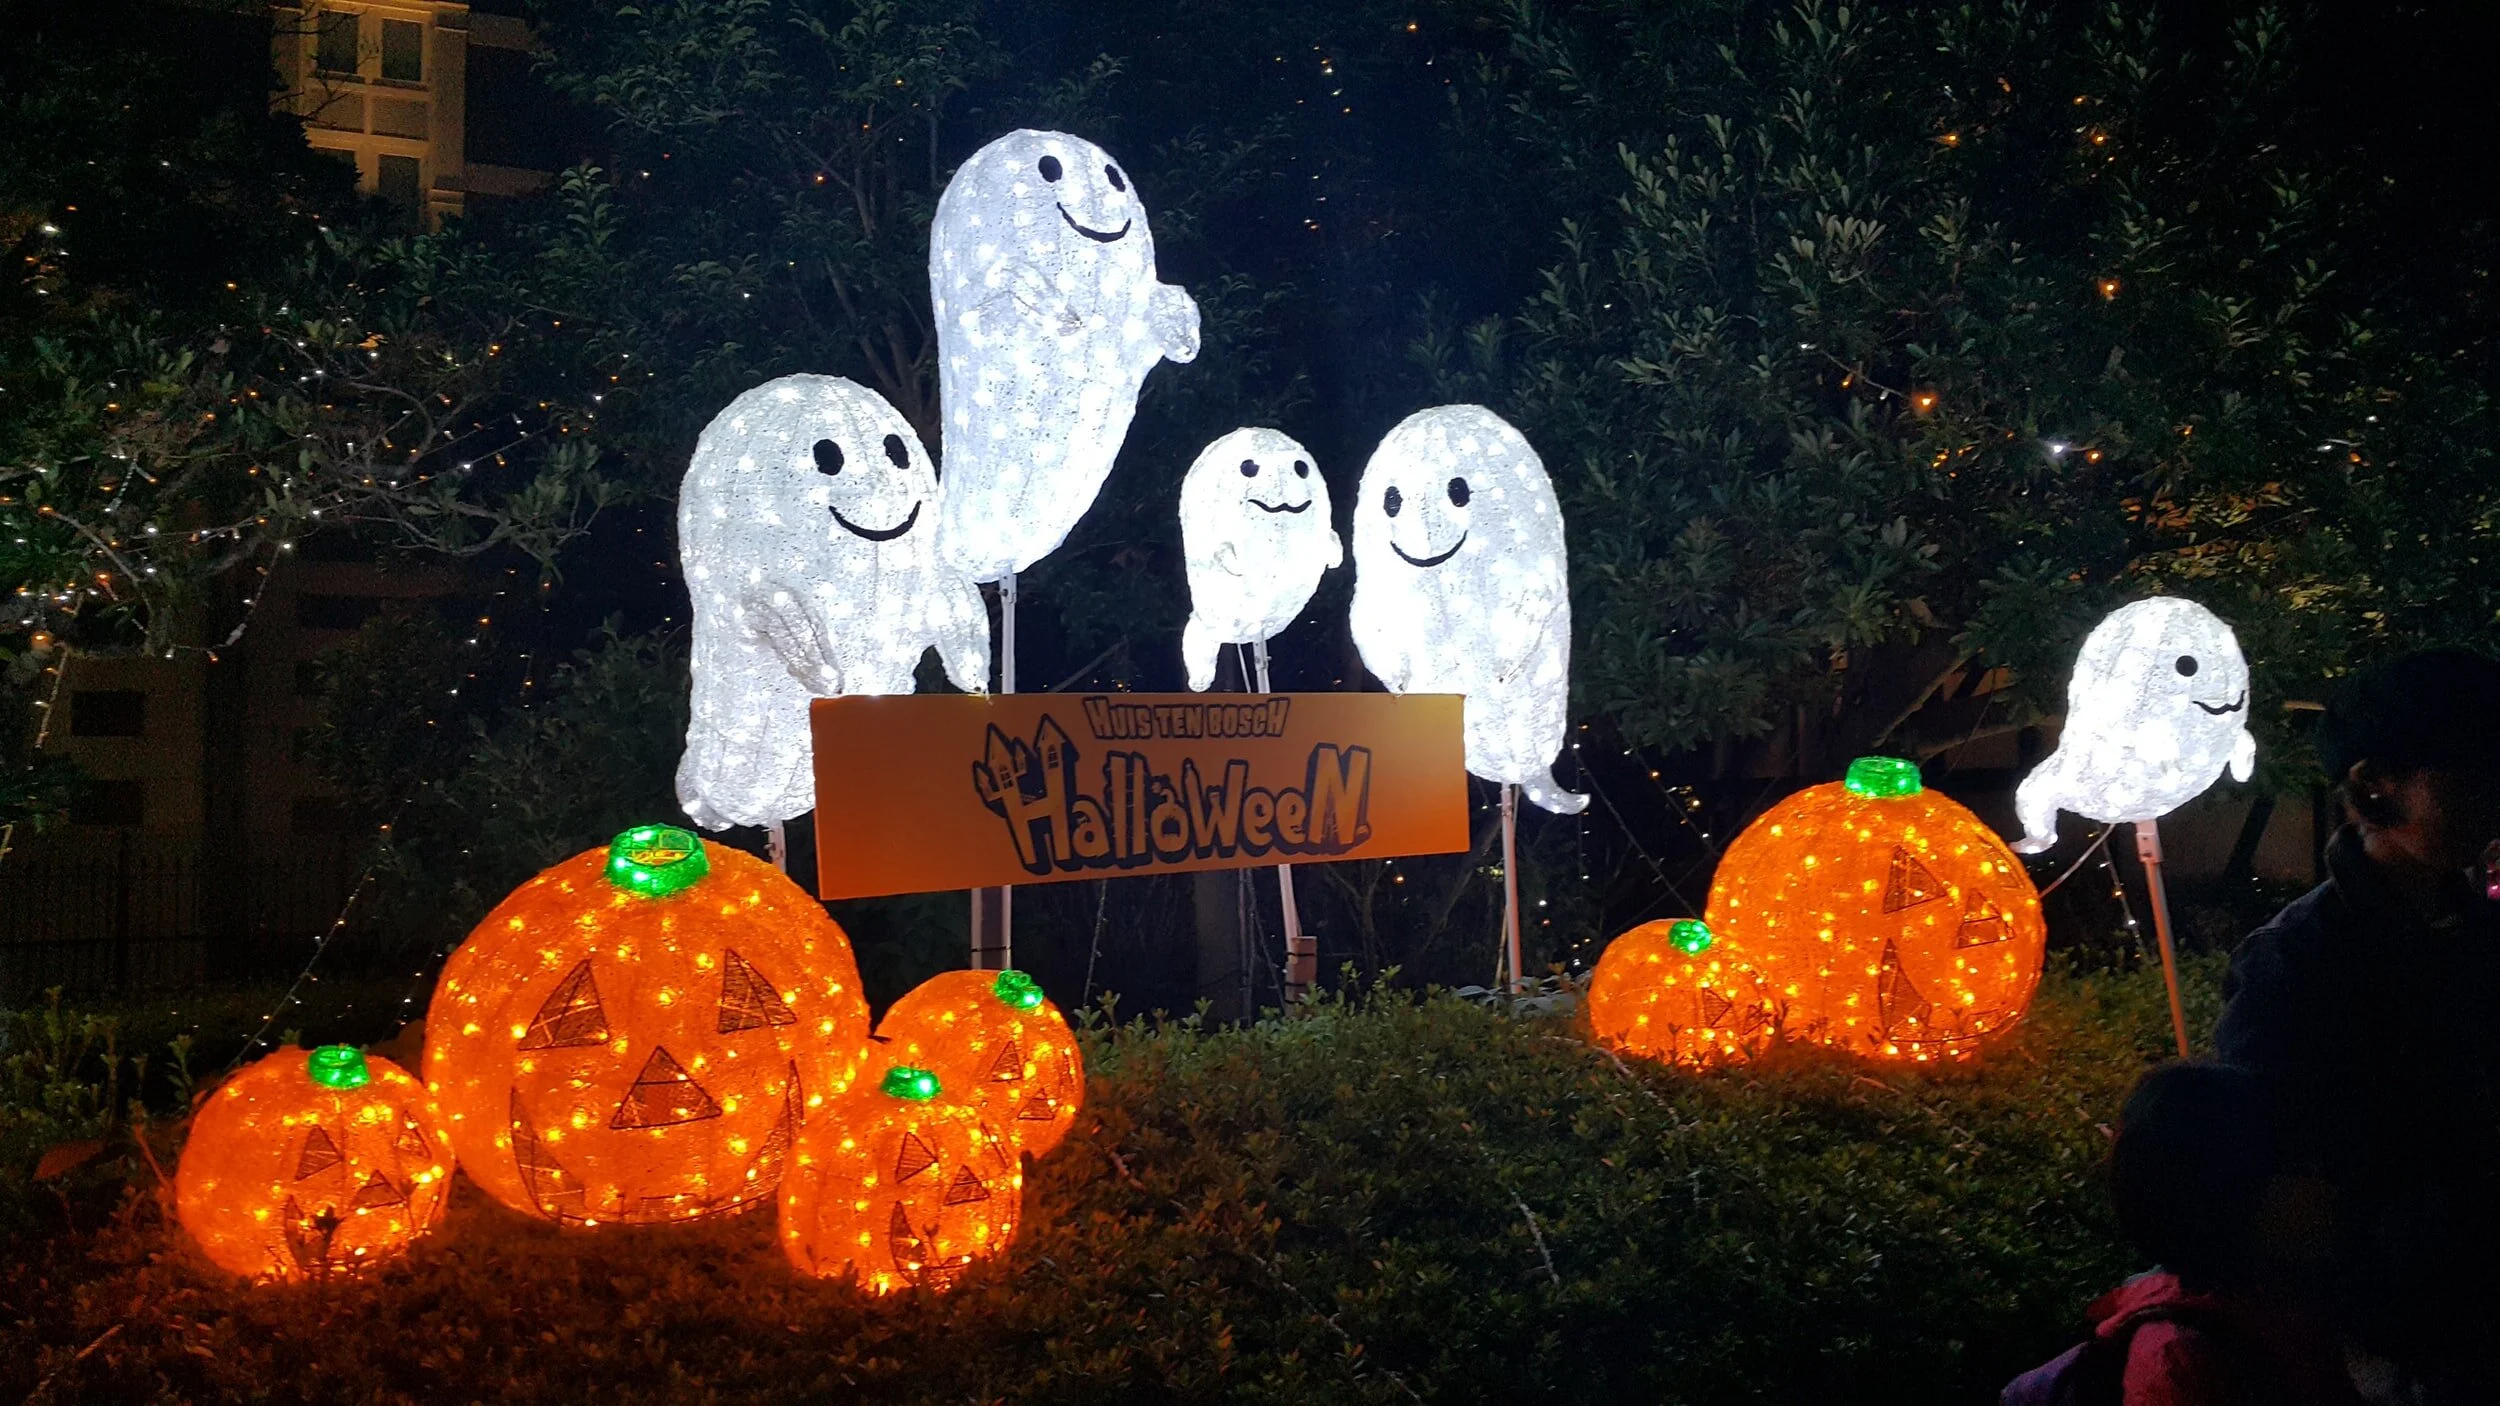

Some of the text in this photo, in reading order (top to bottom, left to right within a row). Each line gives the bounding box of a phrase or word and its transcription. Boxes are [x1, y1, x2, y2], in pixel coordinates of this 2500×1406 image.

[1083, 696, 1290, 739] HUIS TEN BOSCH
